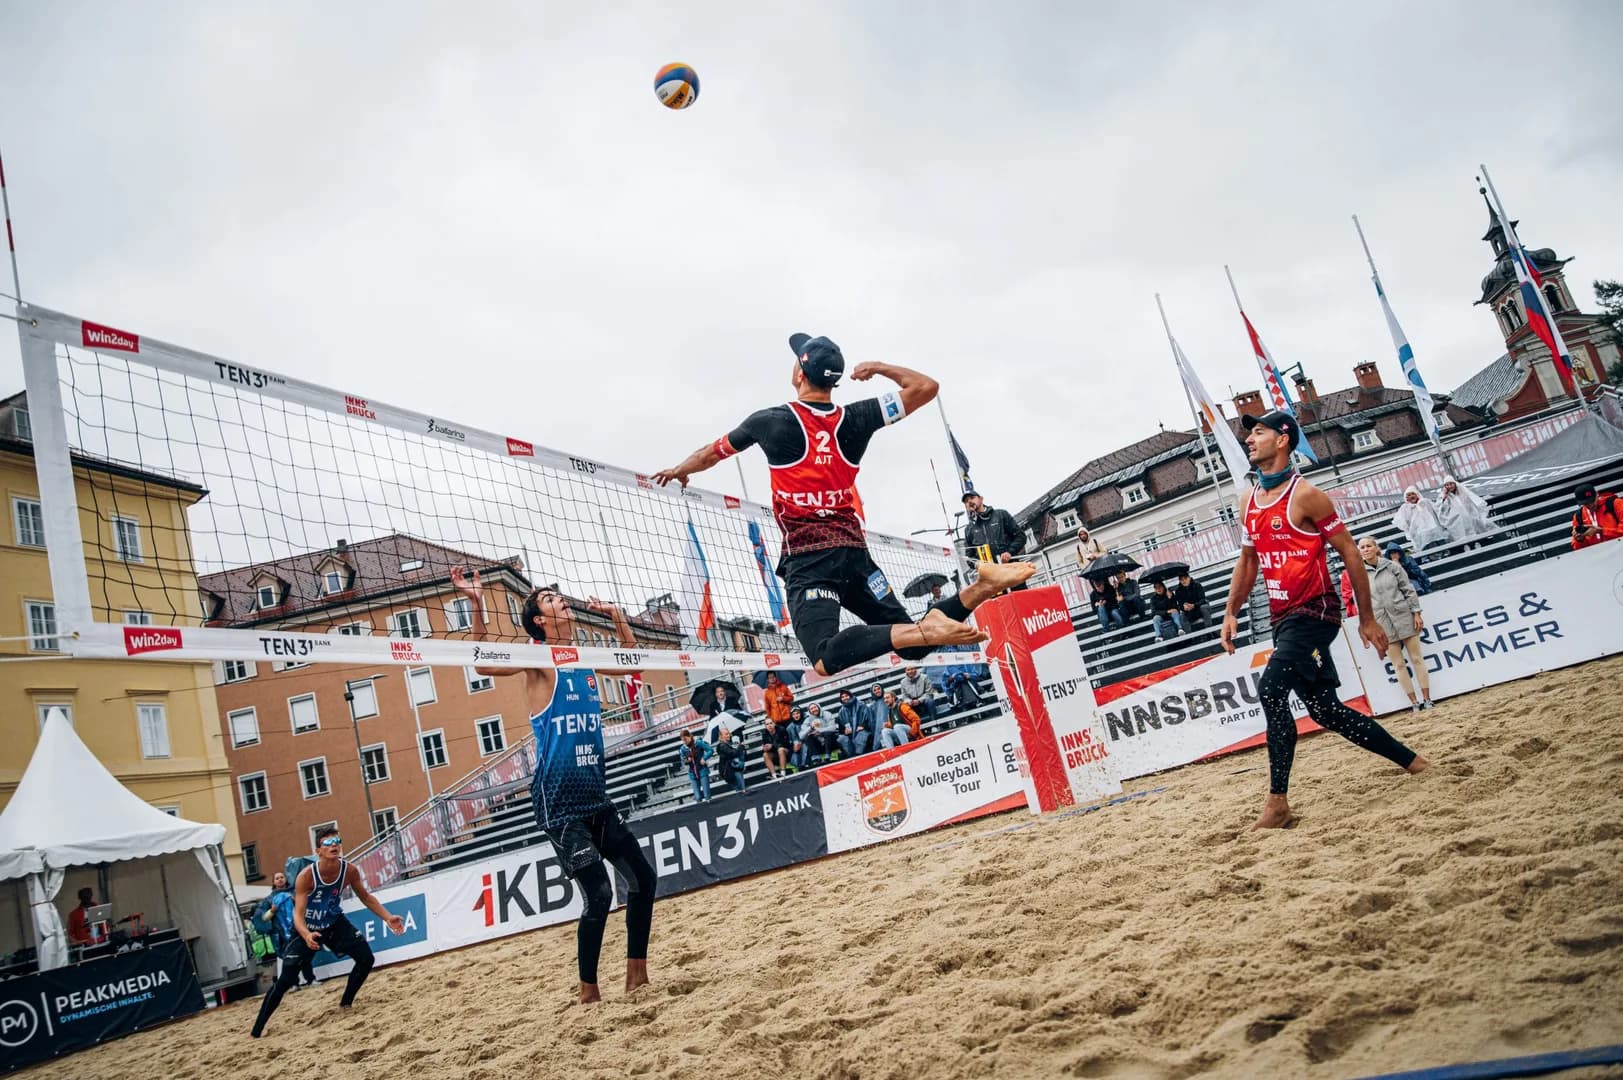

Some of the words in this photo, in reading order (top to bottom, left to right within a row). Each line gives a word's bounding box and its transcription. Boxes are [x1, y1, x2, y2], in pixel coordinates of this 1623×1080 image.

[346, 405, 377, 420] BRUCK
[815, 431, 831, 453] 2
[815, 455, 833, 465] AJT
[1250, 519, 1256, 532] 1
[1023, 606, 1068, 636] win2day
[1420, 605, 1510, 644] REES
[1519, 592, 1553, 617] &
[129, 633, 177, 649] win2day
[314, 639, 332, 647] BANK
[391, 652, 423, 661] BRUCK
[566, 678, 574, 692] 1
[1219, 711, 1246, 726] PART
[1249, 707, 1261, 719] OF
[936, 747, 976, 768] Beach
[1002, 742, 1019, 774] PRO
[1066, 743, 1110, 769] BRUCK
[917, 761, 979, 788] Volleyball
[952, 779, 982, 795] Tour
[762, 793, 812, 820] BANK
[315, 890, 323, 898] 2
[55, 970, 172, 1013] PEAKMEDIA
[60, 1000, 118, 1024] DYNAMISCHE
[118, 991, 156, 1008] INHALTE.
[1, 1012, 28, 1034] PM
